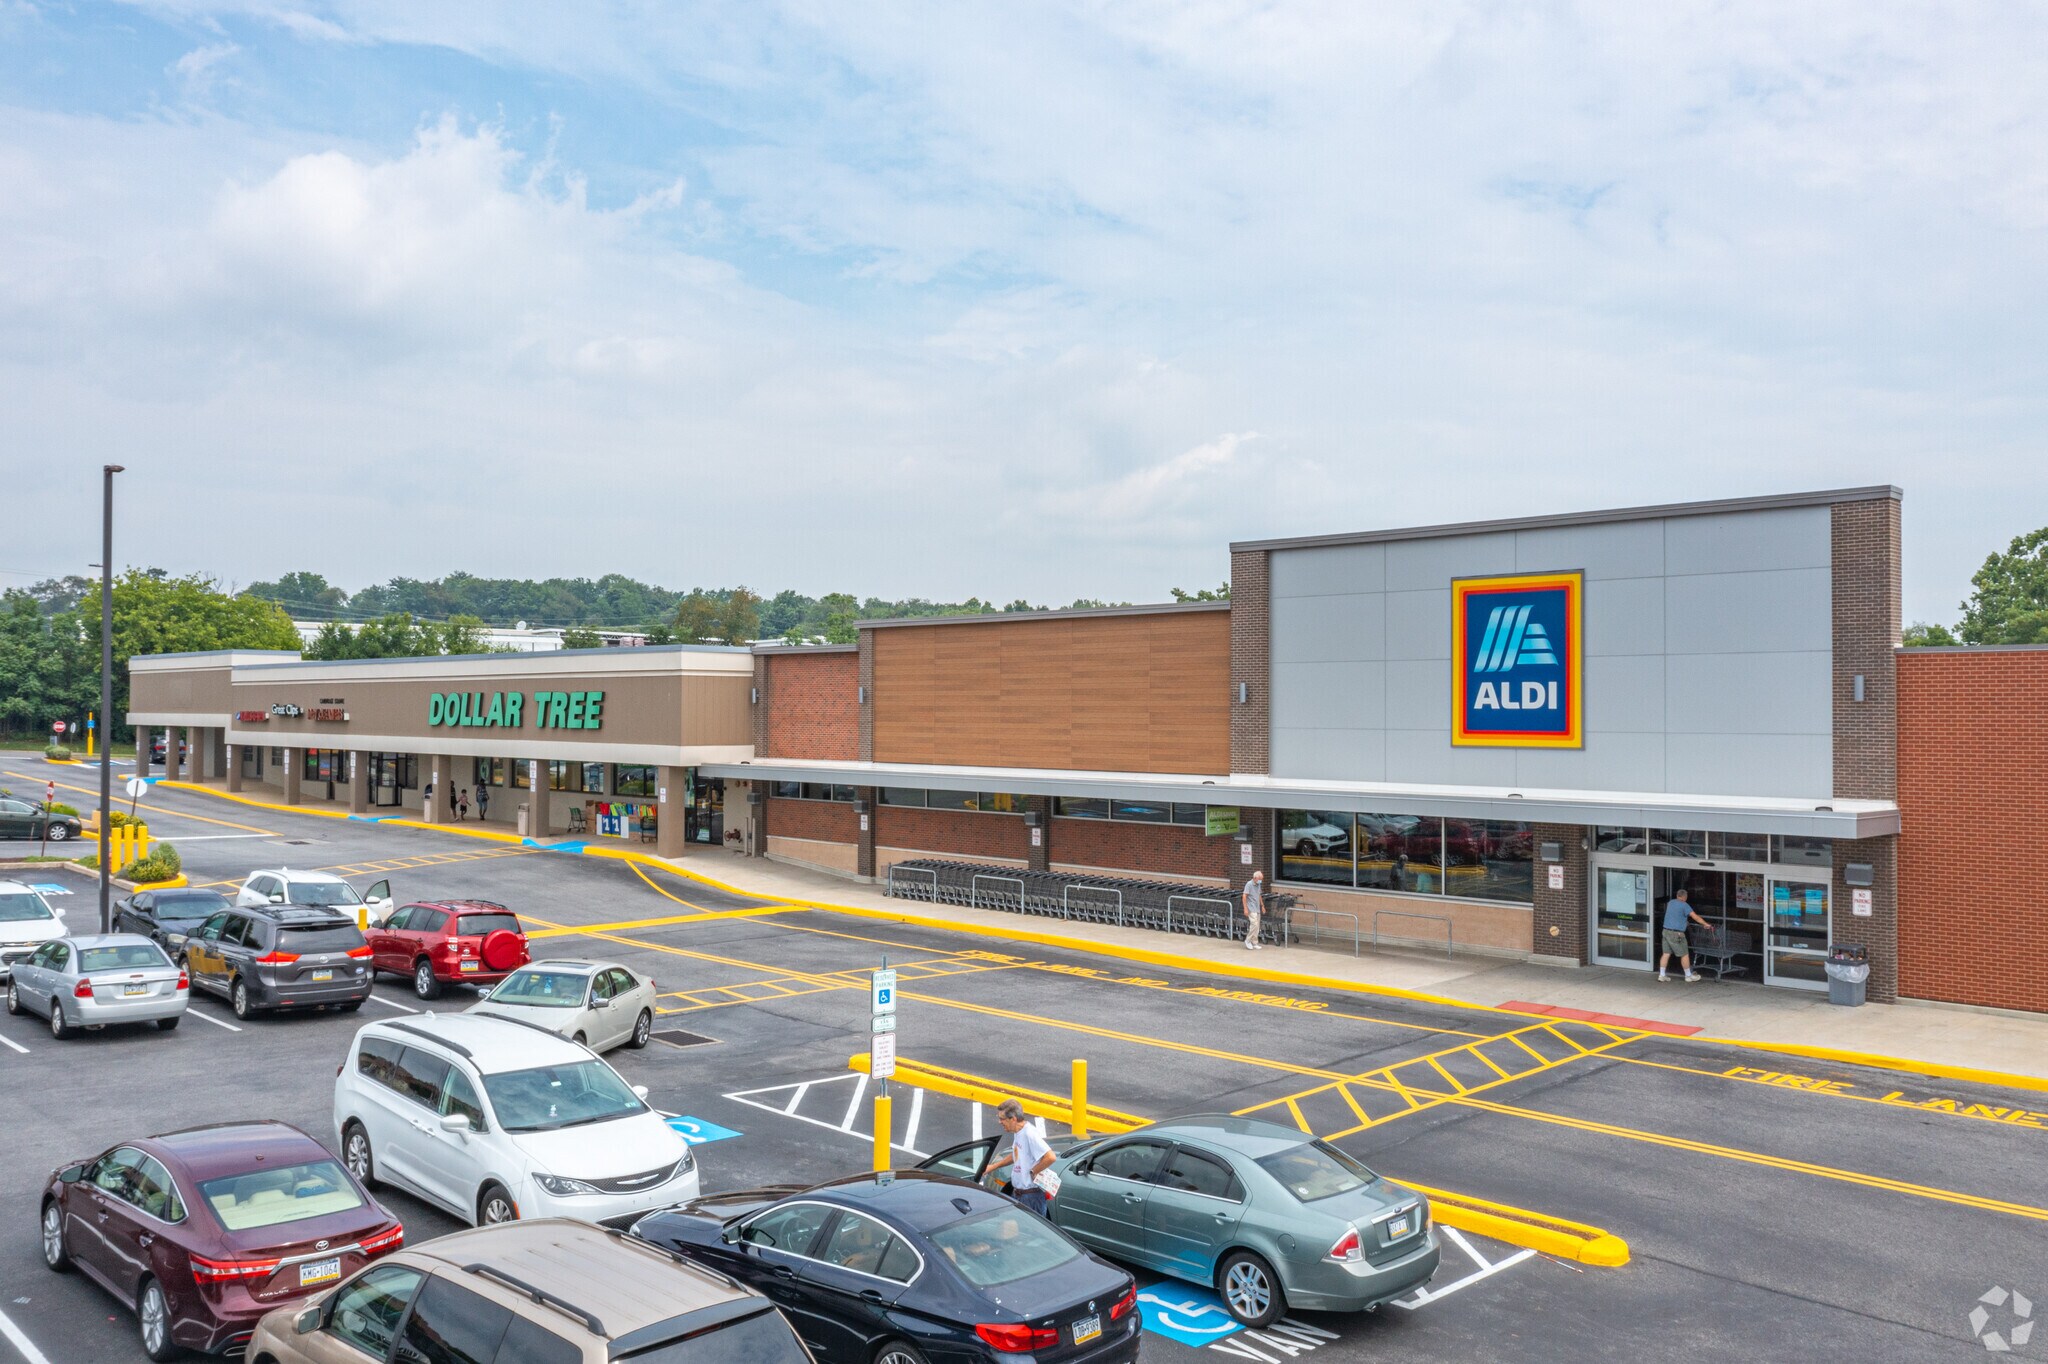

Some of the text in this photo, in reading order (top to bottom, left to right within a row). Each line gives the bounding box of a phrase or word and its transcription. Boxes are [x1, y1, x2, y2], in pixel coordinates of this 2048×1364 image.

[272, 703, 298, 717] Great Clips
[428, 691, 603, 729] DOLLAR TREE
[1474, 681, 1557, 710] ALDI
[1117, 977, 1170, 987] NO
[1181, 986, 1330, 1010] PARKING
[1723, 1066, 2048, 1126] FIRE LANE
[1208, 1316, 1342, 1364] VAN
